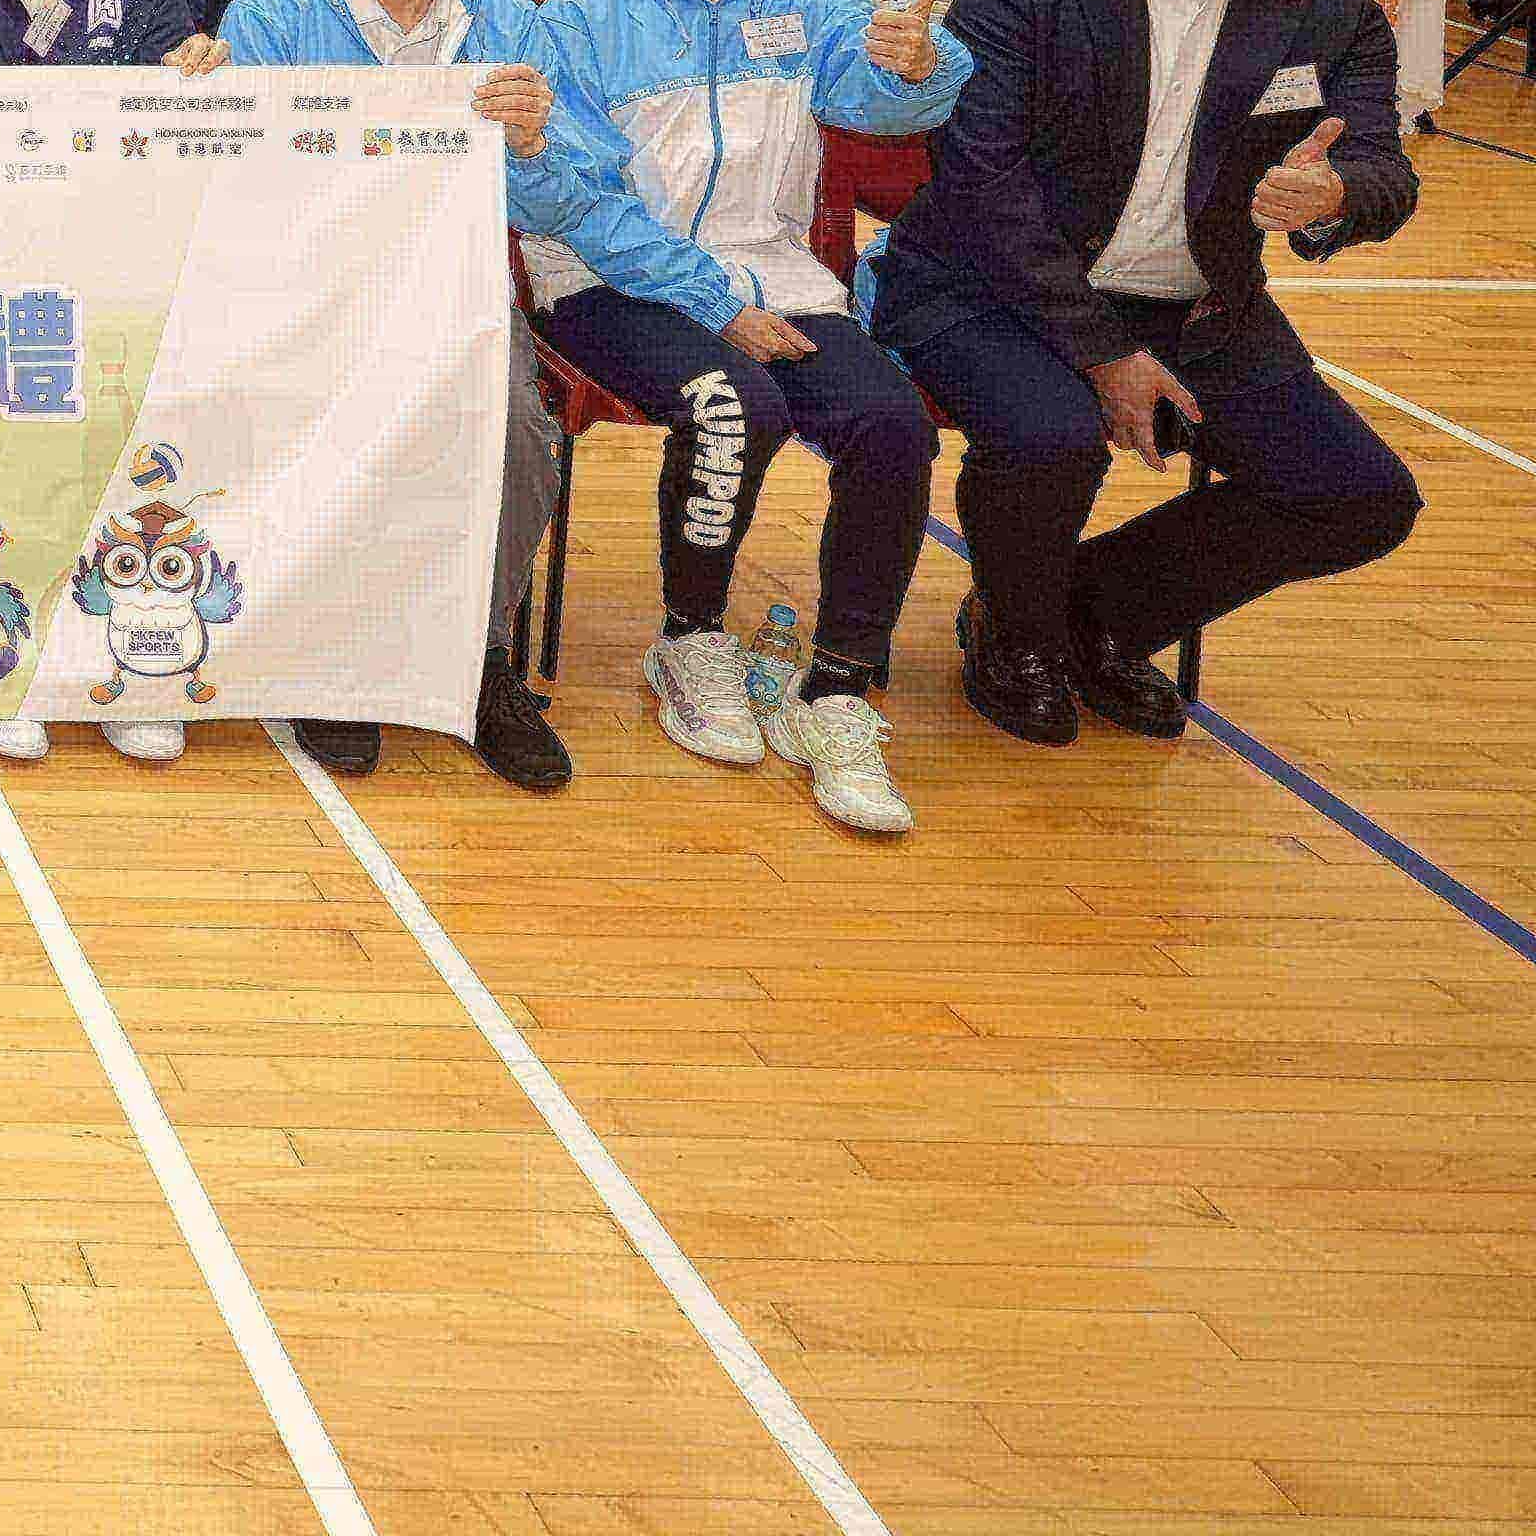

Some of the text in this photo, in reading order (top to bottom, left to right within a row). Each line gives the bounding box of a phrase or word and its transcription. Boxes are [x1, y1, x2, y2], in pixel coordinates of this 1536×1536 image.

[680, 369, 750, 548] KUMPOO
[128, 630, 175, 641] HKFEW
[127, 639, 180, 653] SPORTS
